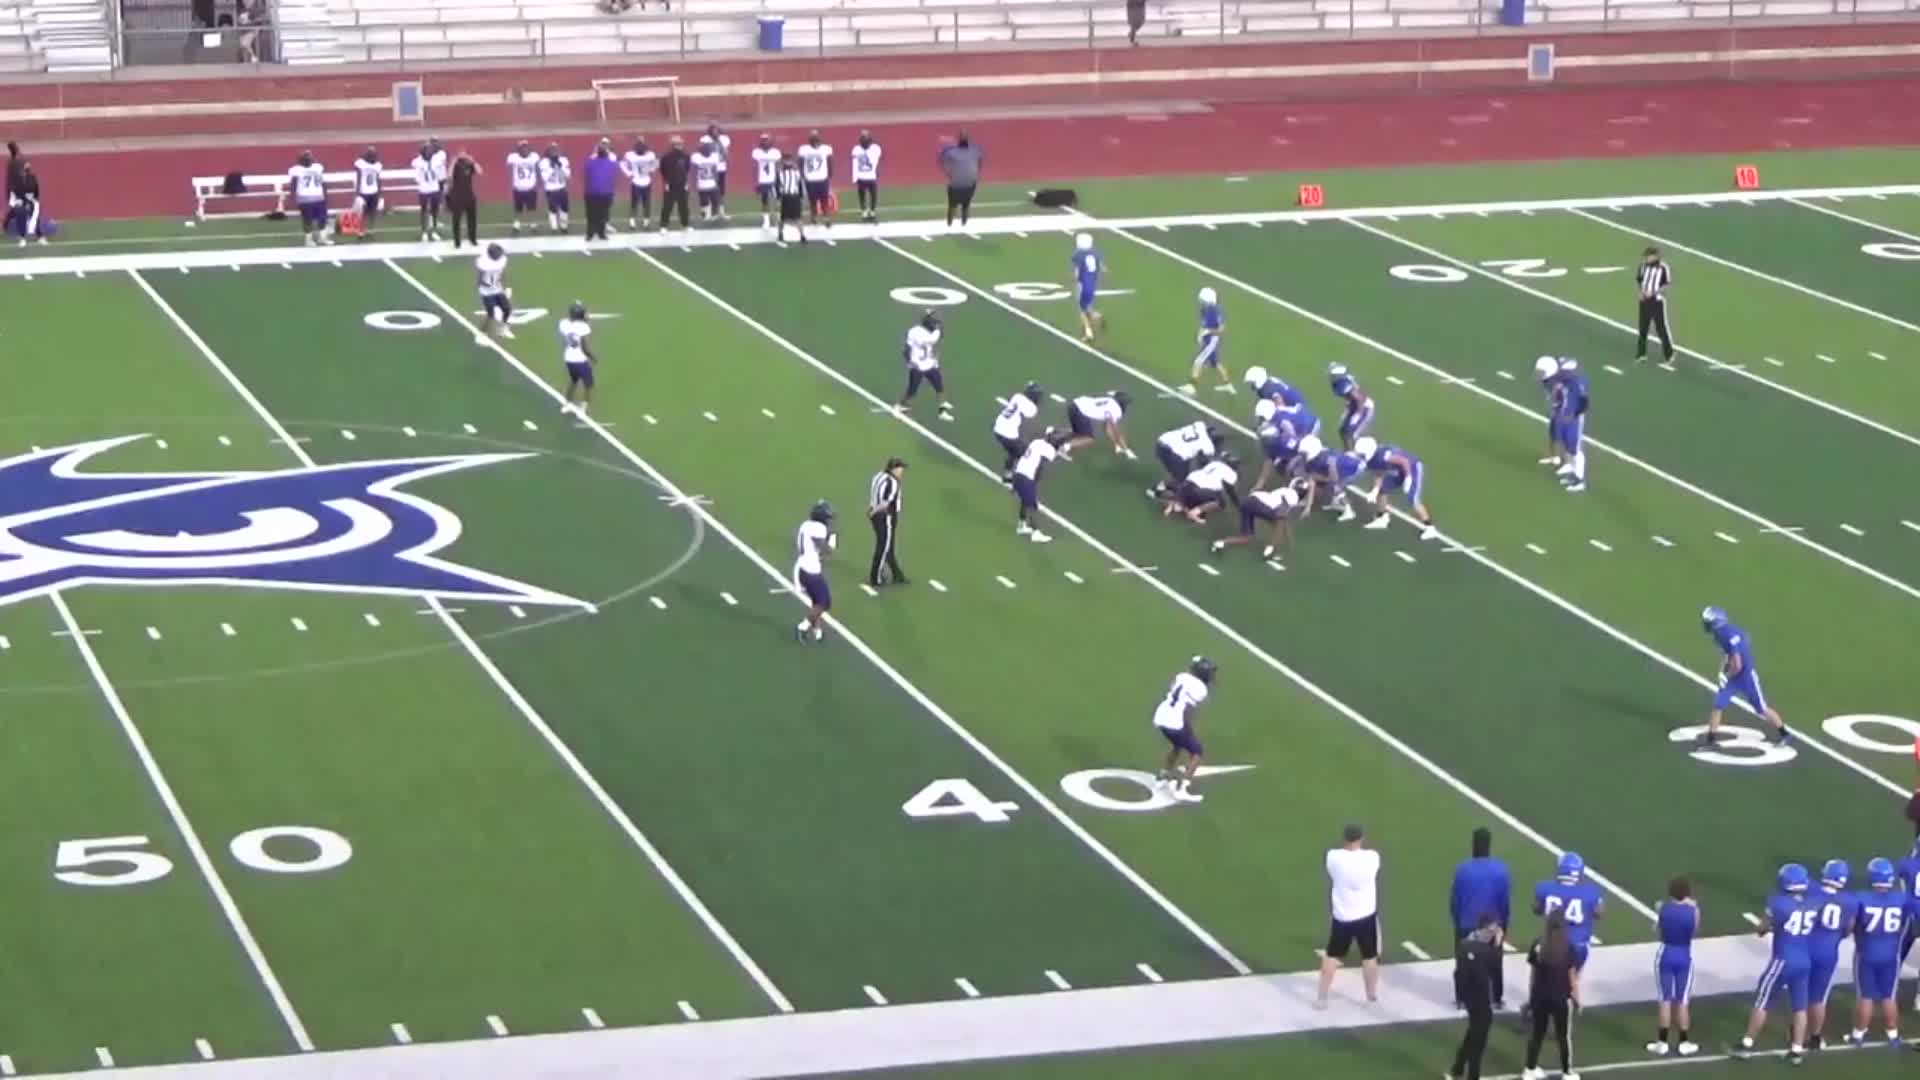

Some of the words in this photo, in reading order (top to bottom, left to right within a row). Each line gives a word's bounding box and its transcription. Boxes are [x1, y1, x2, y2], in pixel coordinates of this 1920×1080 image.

[1740, 168, 1756, 185] 10
[1304, 186, 1320, 204] 20
[1783, 909, 1818, 936] 45
[1864, 906, 1903, 933] 76
